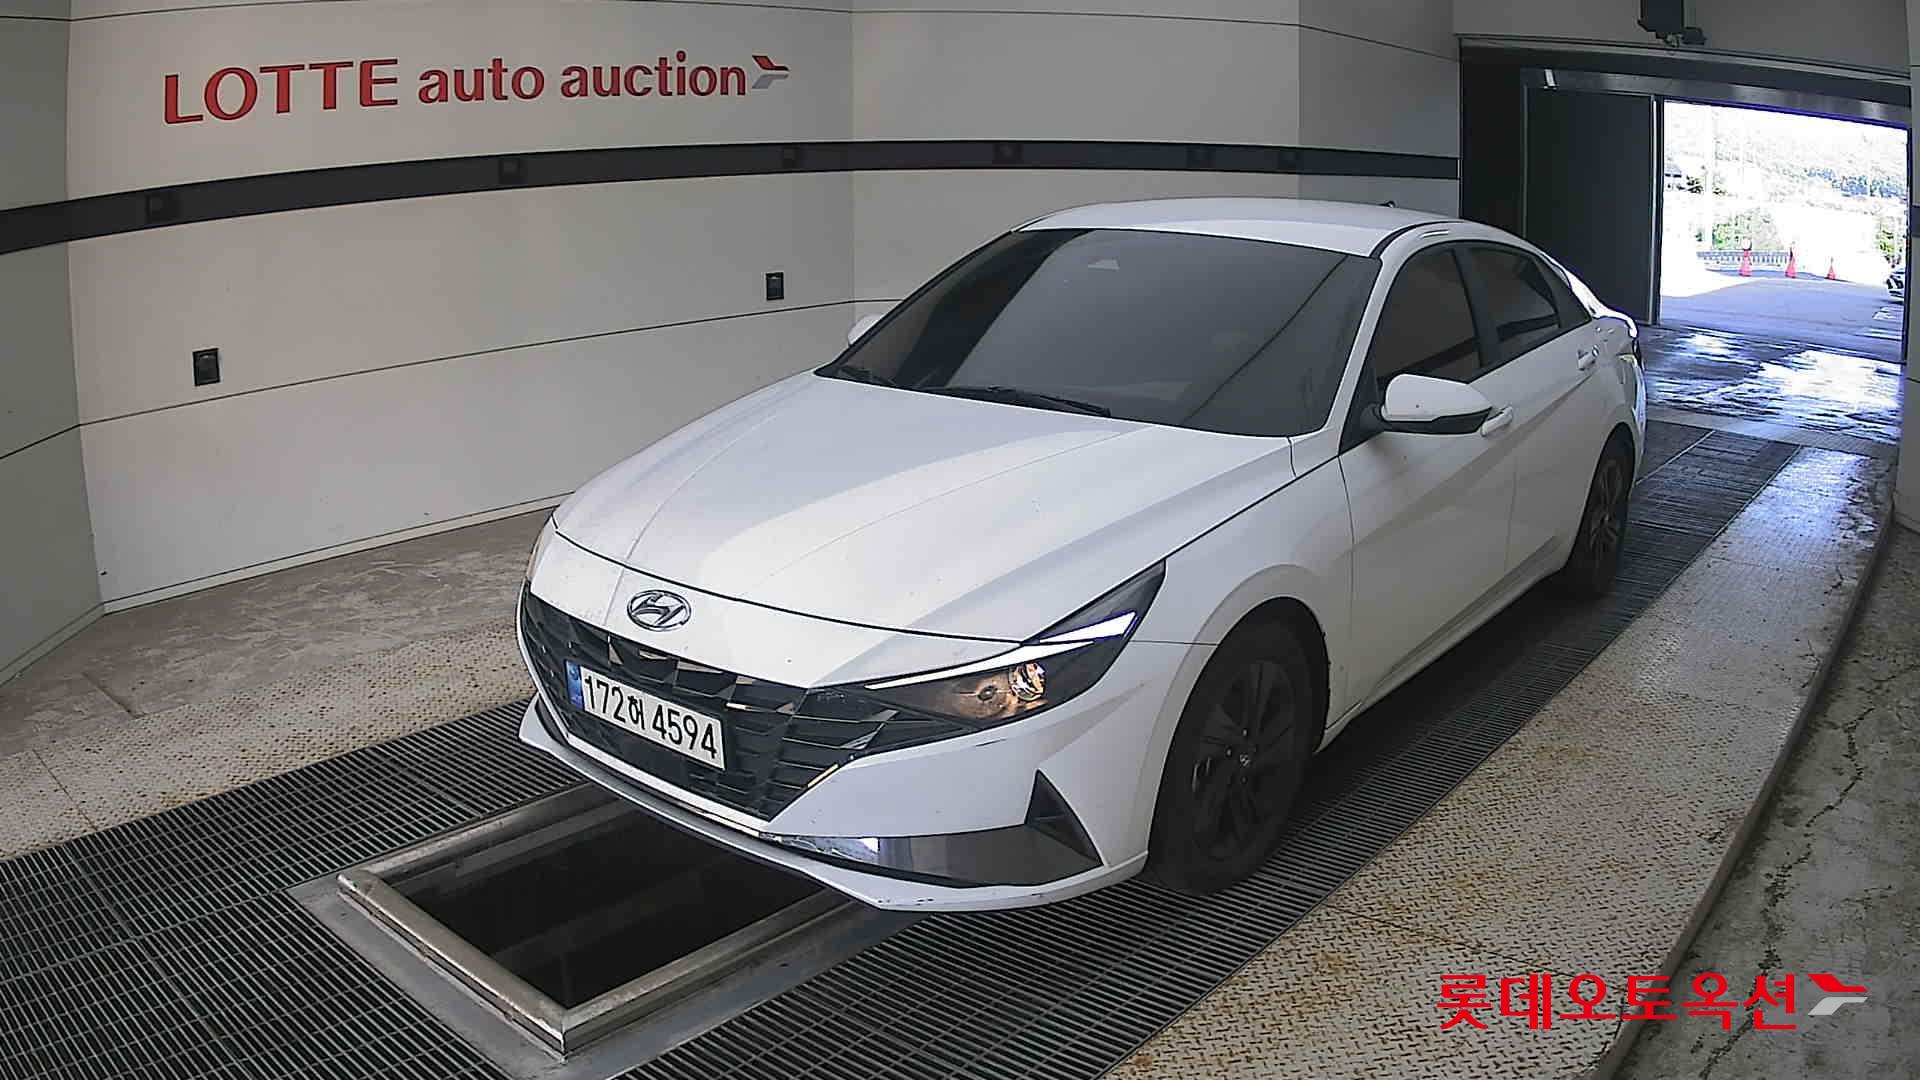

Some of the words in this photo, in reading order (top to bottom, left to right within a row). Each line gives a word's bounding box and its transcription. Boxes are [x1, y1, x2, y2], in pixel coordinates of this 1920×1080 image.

[165, 58, 398, 124] LOTTE
[417, 57, 544, 103] auto
[560, 50, 748, 98] auction
[652, 704, 718, 760] 4594
